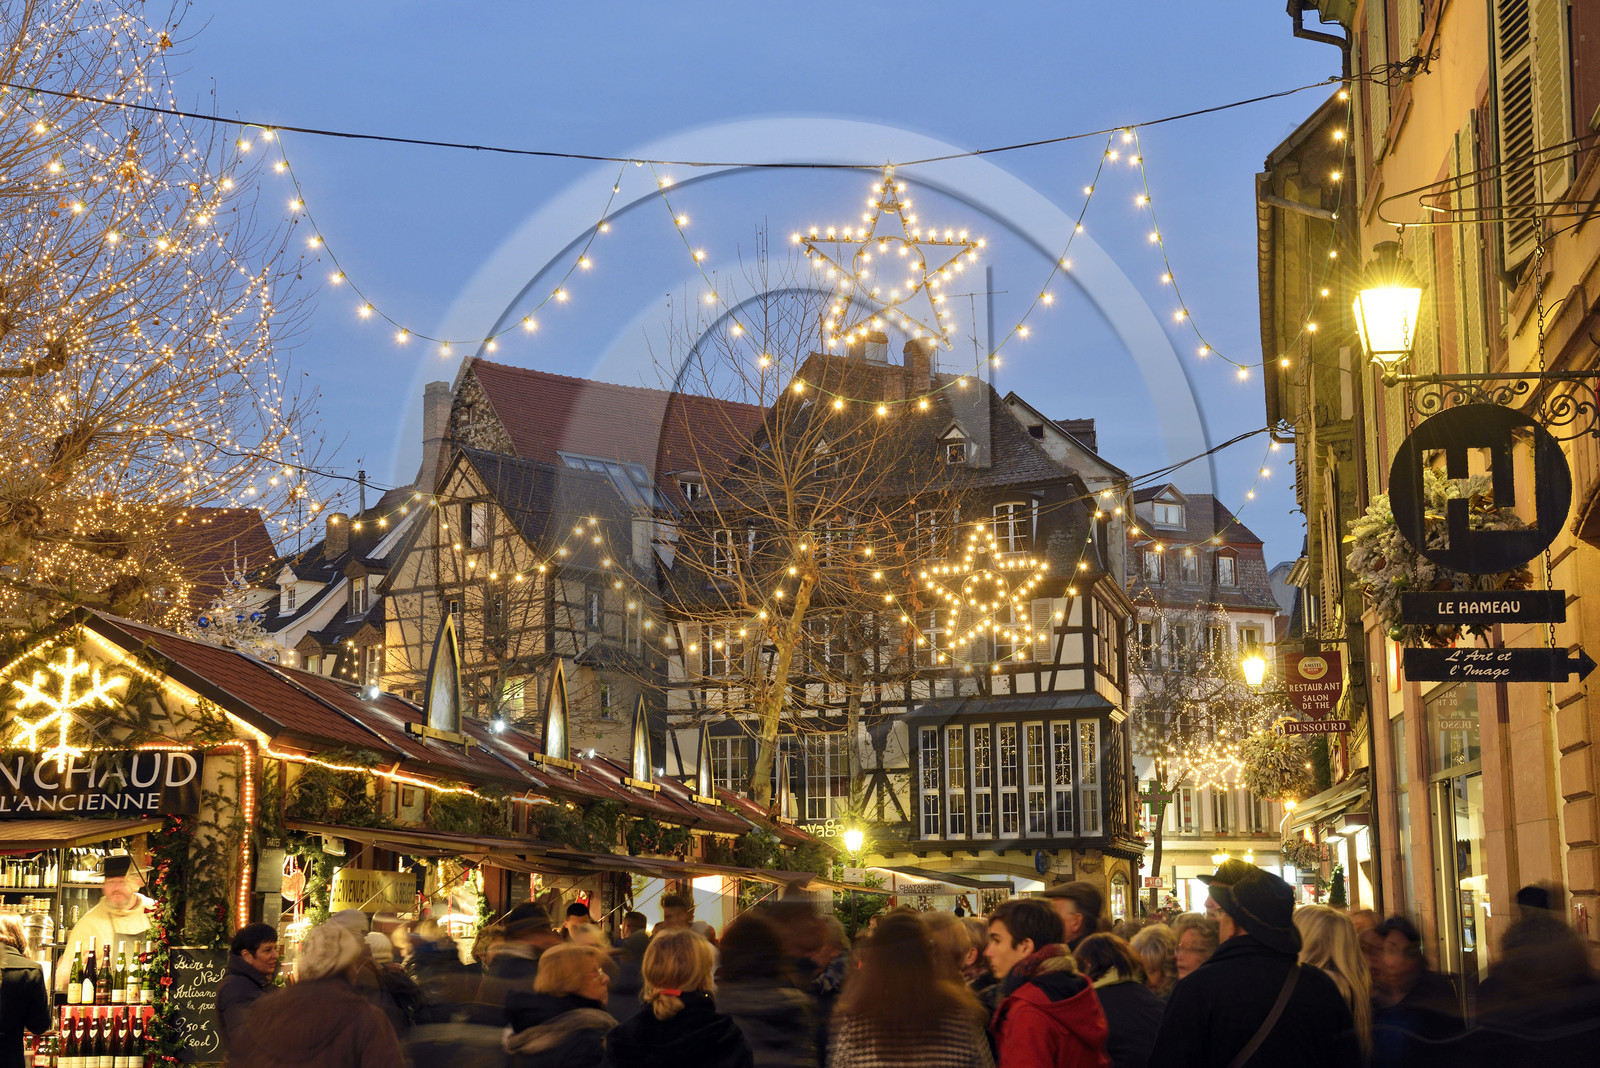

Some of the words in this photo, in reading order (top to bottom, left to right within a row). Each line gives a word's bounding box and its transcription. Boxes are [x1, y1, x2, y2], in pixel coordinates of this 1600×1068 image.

[1438, 602, 1455, 614] LE
[1458, 601, 1521, 614] HAMEAU
[1497, 651, 1512, 661] et
[1289, 682, 1341, 692] RESTAURANT
[1302, 694, 1329, 702] SALON
[1289, 722, 1346, 732] DUSSOURD
[33, 752, 197, 790] CHAUD
[0, 792, 161, 812] L'ANCIENNE
